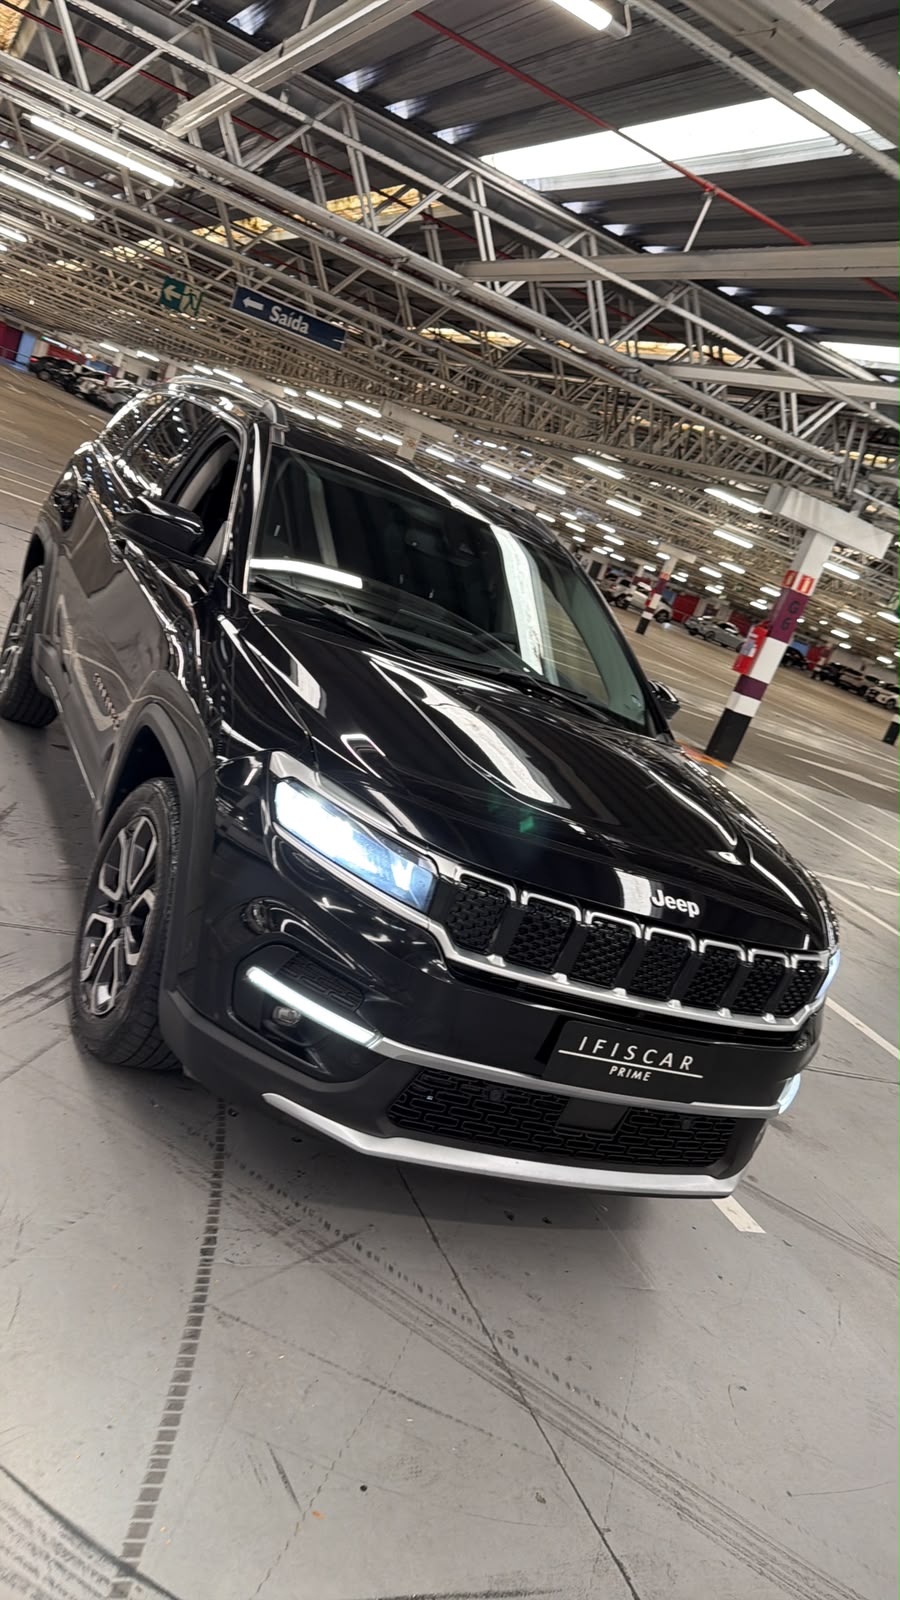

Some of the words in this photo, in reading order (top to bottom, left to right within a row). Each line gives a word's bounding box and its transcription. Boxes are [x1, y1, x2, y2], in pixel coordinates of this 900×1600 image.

[270, 306, 309, 334] Saída
[651, 889, 700, 918] Jeep
[578, 1036, 694, 1071] IFISCAR
[609, 1066, 652, 1082] PRIME
